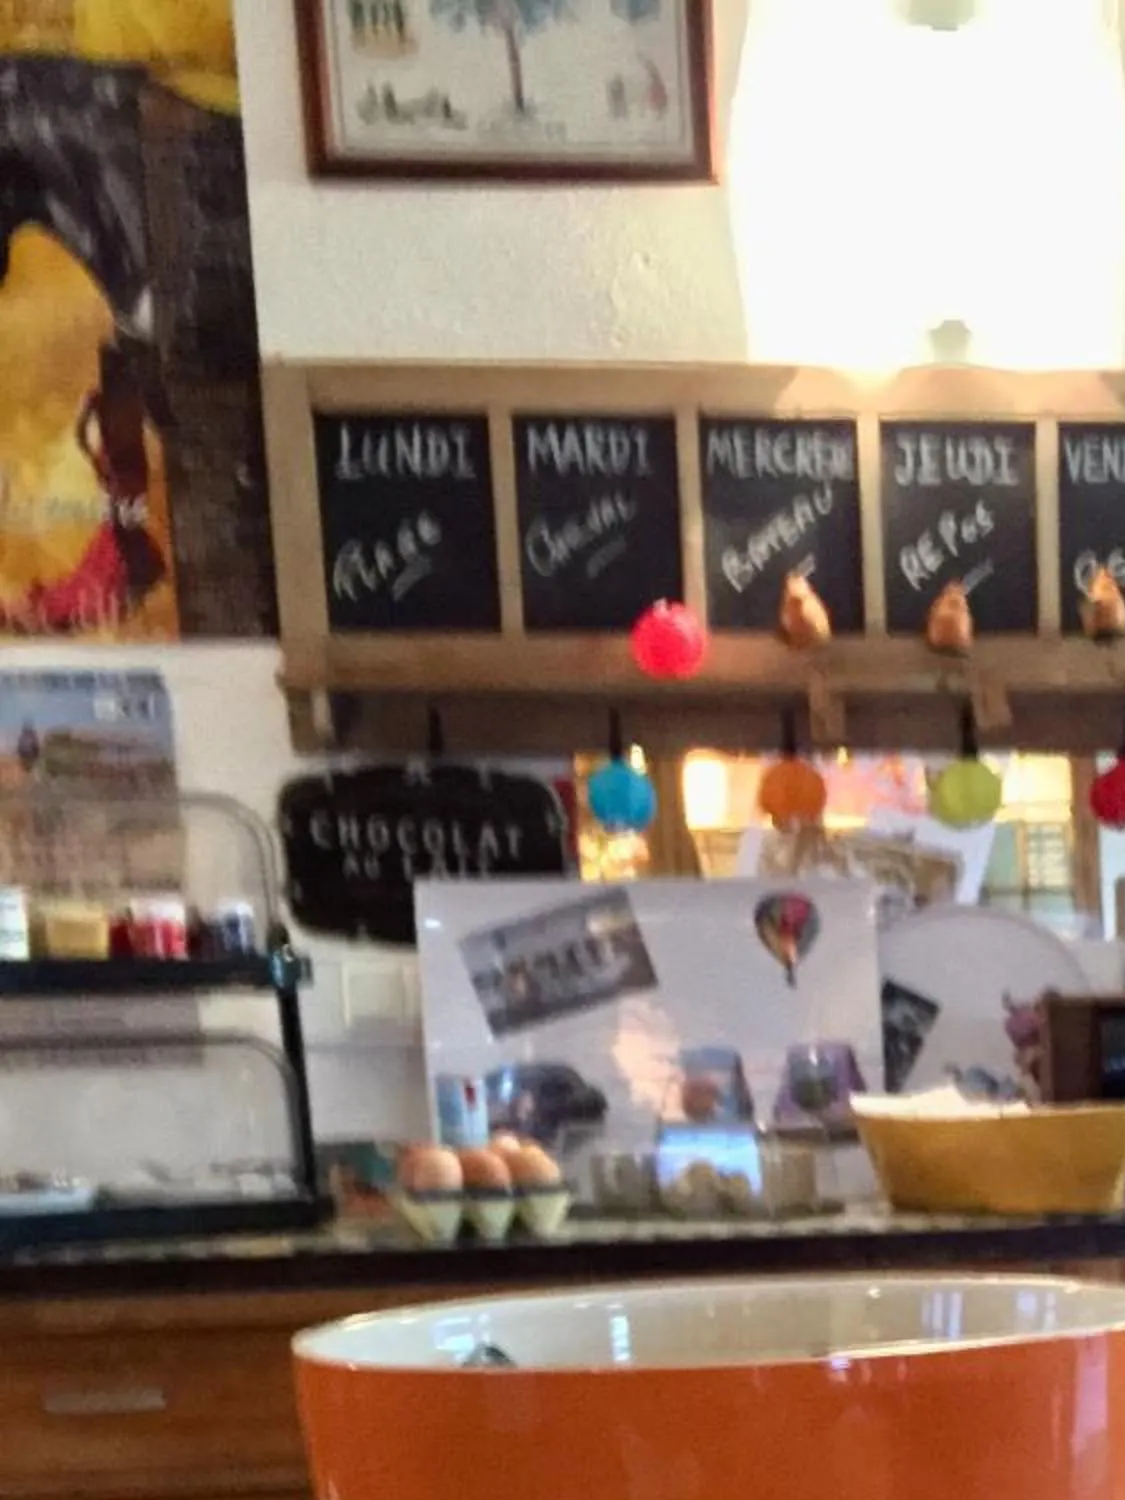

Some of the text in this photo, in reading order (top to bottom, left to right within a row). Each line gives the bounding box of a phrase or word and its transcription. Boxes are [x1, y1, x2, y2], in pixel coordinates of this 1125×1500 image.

[335, 421, 476, 481] LUNDI
[526, 421, 656, 478] MARDI
[893, 431, 1020, 488] JEUDI
[308, 809, 523, 860] CHOCOLAT
